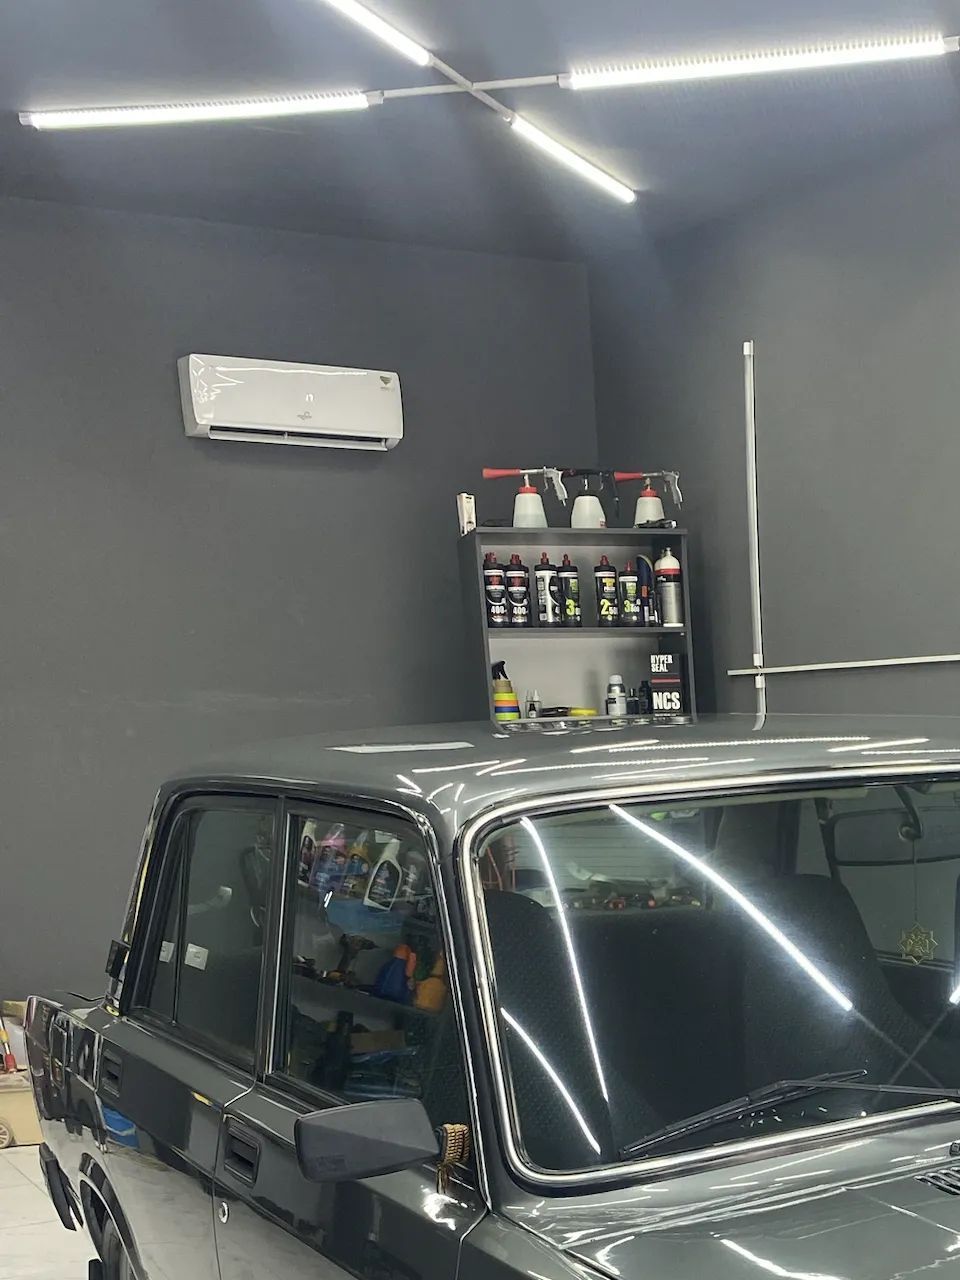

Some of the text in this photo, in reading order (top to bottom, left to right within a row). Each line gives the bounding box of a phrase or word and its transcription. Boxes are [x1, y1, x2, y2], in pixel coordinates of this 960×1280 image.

[650, 654, 673, 664] HYPER
[651, 664, 669, 672] SEAL
[652, 691, 680, 710] NCS
